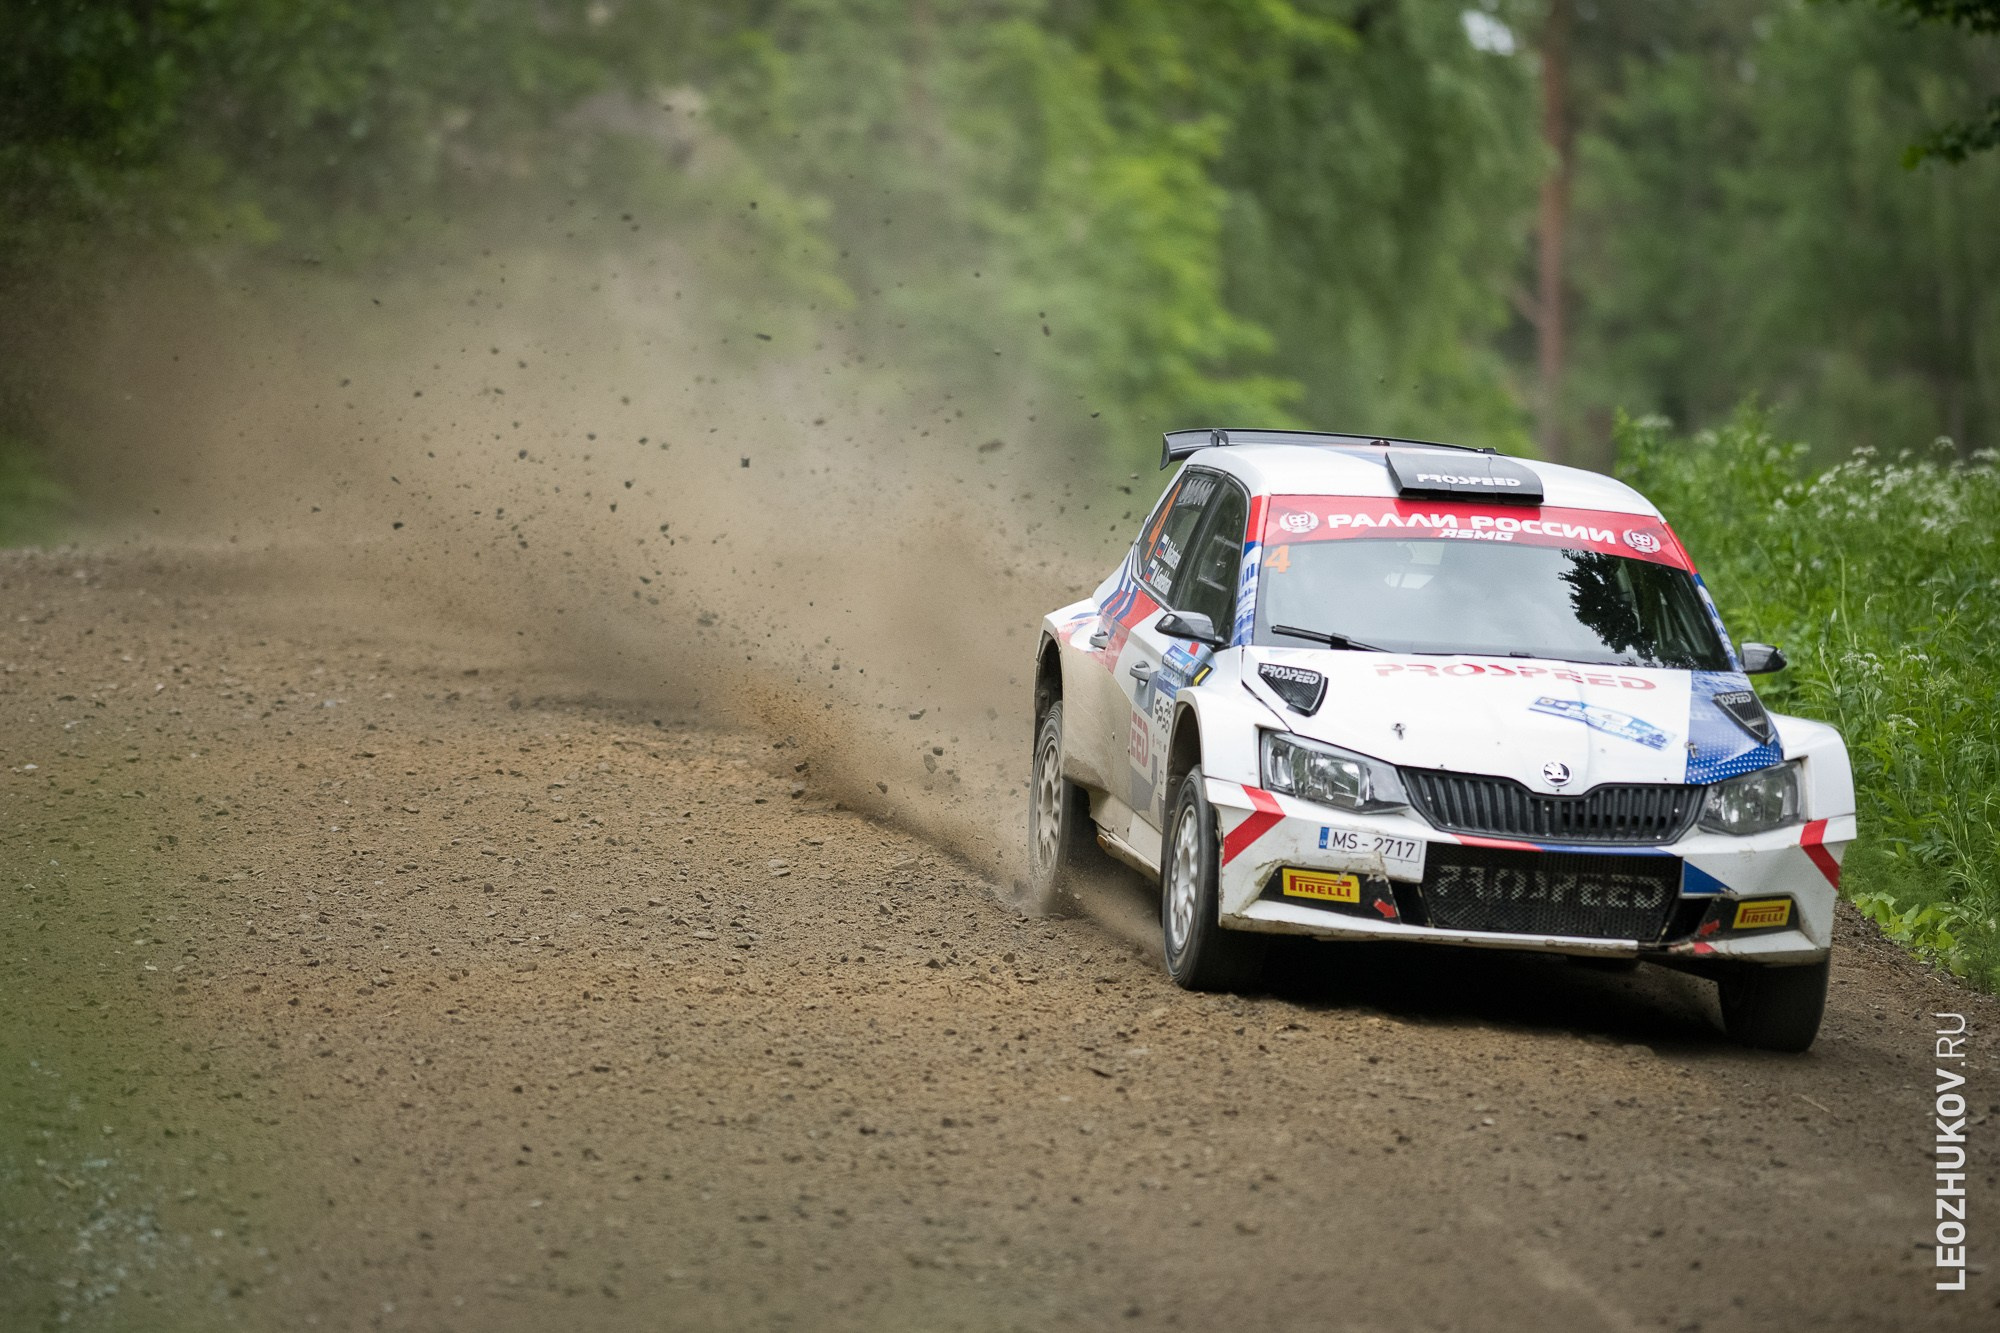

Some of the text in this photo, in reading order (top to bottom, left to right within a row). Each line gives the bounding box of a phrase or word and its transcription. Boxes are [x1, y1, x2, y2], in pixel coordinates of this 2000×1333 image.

[1416, 473, 1521, 487] PROSPEED
[1327, 513, 1458, 529] РАЛЛИ
[1470, 515, 1616, 545] РОССИИ
[1264, 545, 1292, 574] 4
[1261, 664, 1320, 685] PROSPEED
[1373, 663, 1657, 691] PROSPEED
[1289, 875, 1352, 897] PIRELLI
[1740, 906, 1786, 923] PIRELLI
